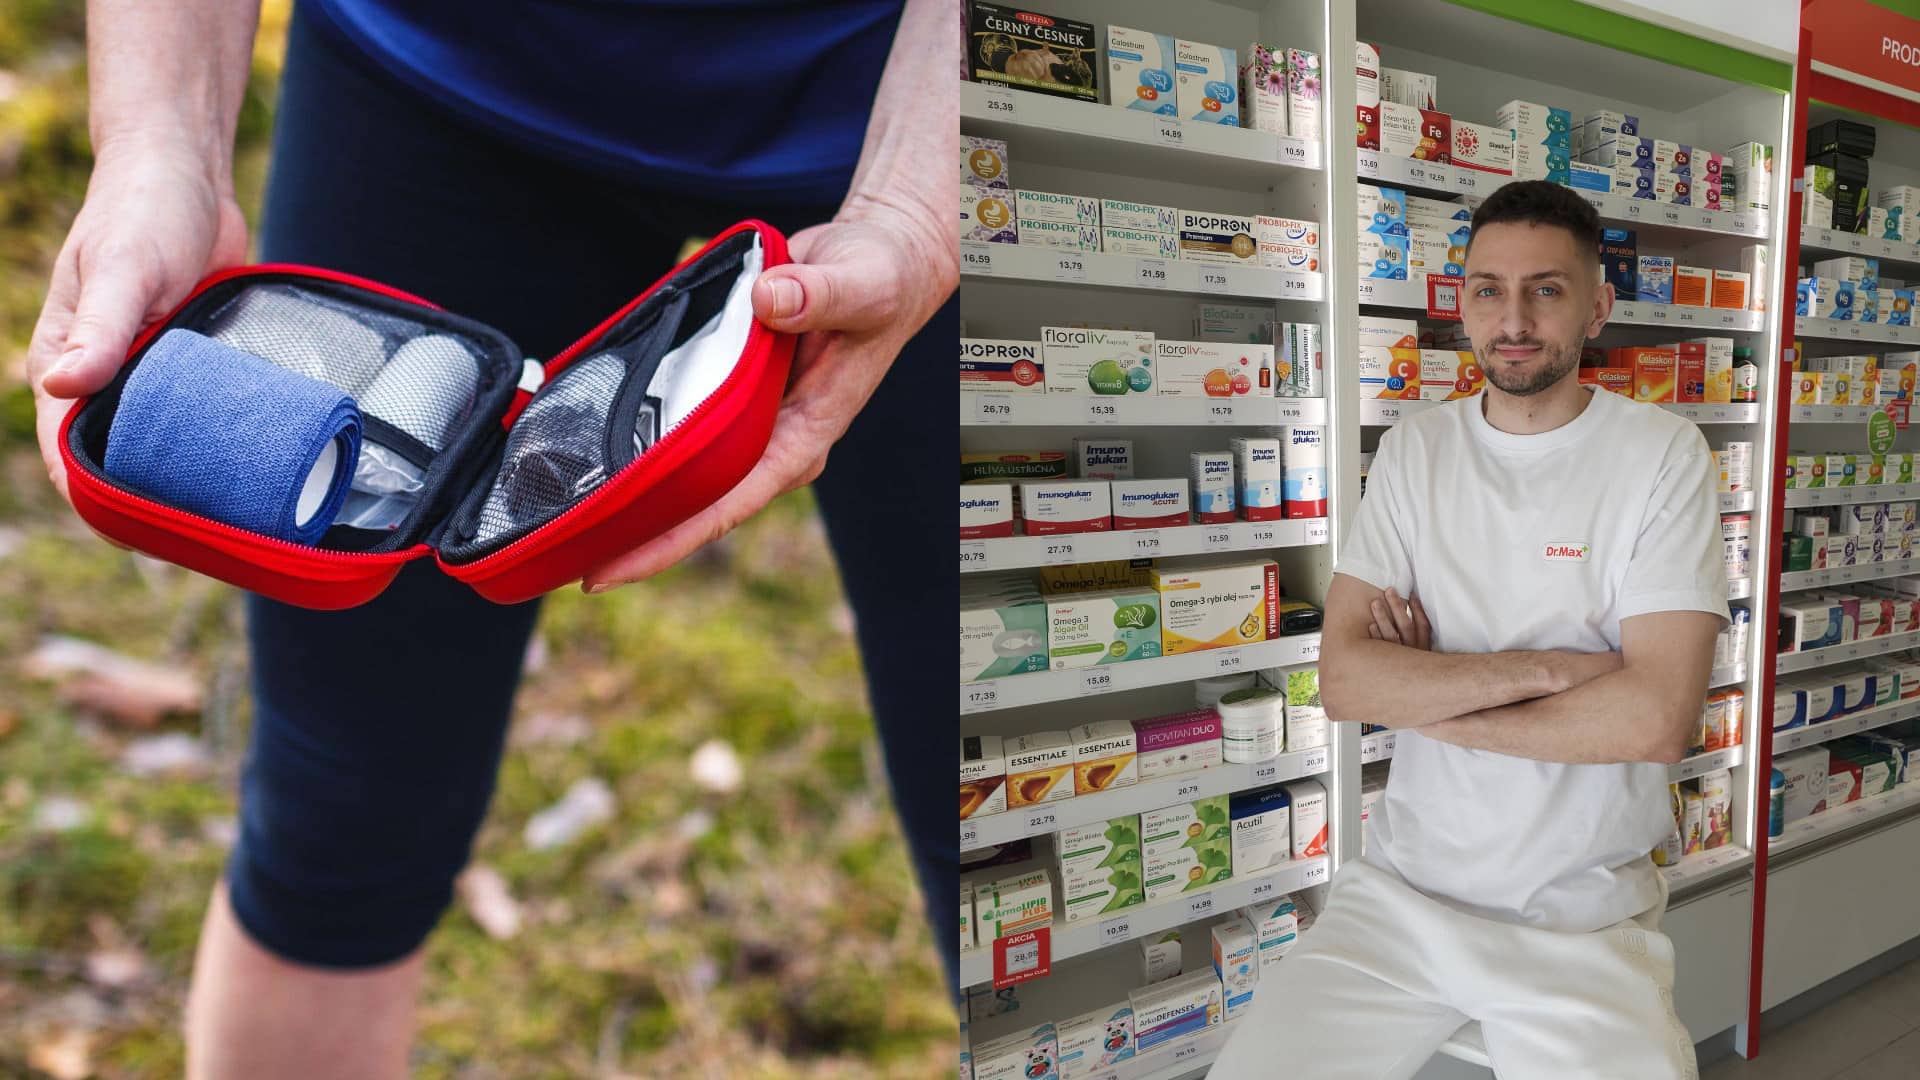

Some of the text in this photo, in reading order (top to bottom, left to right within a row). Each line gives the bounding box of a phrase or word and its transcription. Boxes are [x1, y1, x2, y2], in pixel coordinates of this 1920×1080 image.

[985, 16, 1084, 47] ČERNÝ ČESNEK
[1111, 38, 1145, 50] Colostrum
[1178, 51, 1210, 63] Colostrum
[1882, 37, 1920, 67] PROD
[1360, 110, 1372, 123] Fe
[1429, 126, 1442, 138] Fe
[1624, 125, 1633, 134] Zn
[1640, 148, 1649, 156] Zn
[1640, 179, 1648, 187] Zn
[1018, 191, 1075, 206] PROBIO-FIX
[1105, 201, 1157, 215] PROBIO-FIX
[1383, 203, 1396, 215] Mg
[1020, 219, 1077, 234] PROBIO-FIX
[1184, 215, 1251, 233] BIOPRON
[1257, 217, 1302, 230] PROBIO-FIX
[1106, 229, 1158, 243] PROBIO-FIX
[1185, 233, 1213, 242] Premium
[1260, 244, 1305, 257] PROBIO-FIX
[1385, 249, 1397, 261] Mg
[963, 253, 990, 264] 16,59
[1059, 261, 1082, 270] 13,79
[1142, 269, 1165, 280] 21,59
[1046, 329, 1105, 345] floraliv
[1158, 343, 1200, 356] floraliv
[1639, 352, 1674, 366] Celaskon
[1398, 362, 1409, 377] C
[1466, 365, 1474, 380] C
[1598, 372, 1631, 381] Celaskon
[983, 404, 1010, 414] 26,79
[1091, 405, 1114, 414] 15,39
[1212, 407, 1232, 415] 15,79
[1292, 428, 1318, 437] Imuno
[1293, 436, 1320, 445] glukan
[1086, 446, 1126, 456] Imuno
[1252, 448, 1274, 456] Imuno
[1087, 455, 1127, 467] glukan
[1205, 466, 1230, 474] glukan
[1037, 491, 1092, 500] Imunoglukan
[1122, 491, 1179, 502] Imunoglukan
[1047, 544, 1072, 554] 27,79
[1136, 539, 1159, 547] 11,79
[1170, 596, 1205, 609] Omega-3
[1223, 592, 1237, 603] olej
[1053, 615, 1089, 627] Omega 3
[1053, 623, 1089, 635] Algae Oil
[969, 691, 995, 701] 17,39
[1143, 724, 1215, 745] LIPOVITAN DUO
[1079, 739, 1132, 756] ESSENTIALE
[1011, 750, 1067, 767] ESSENTIALE
[1030, 815, 1055, 825] 22,79
[1236, 817, 1262, 831] Acutil
[1191, 899, 1211, 911] 14,99
[1022, 905, 1047, 919] PLUS
[1007, 932, 1036, 945] AKCIA
